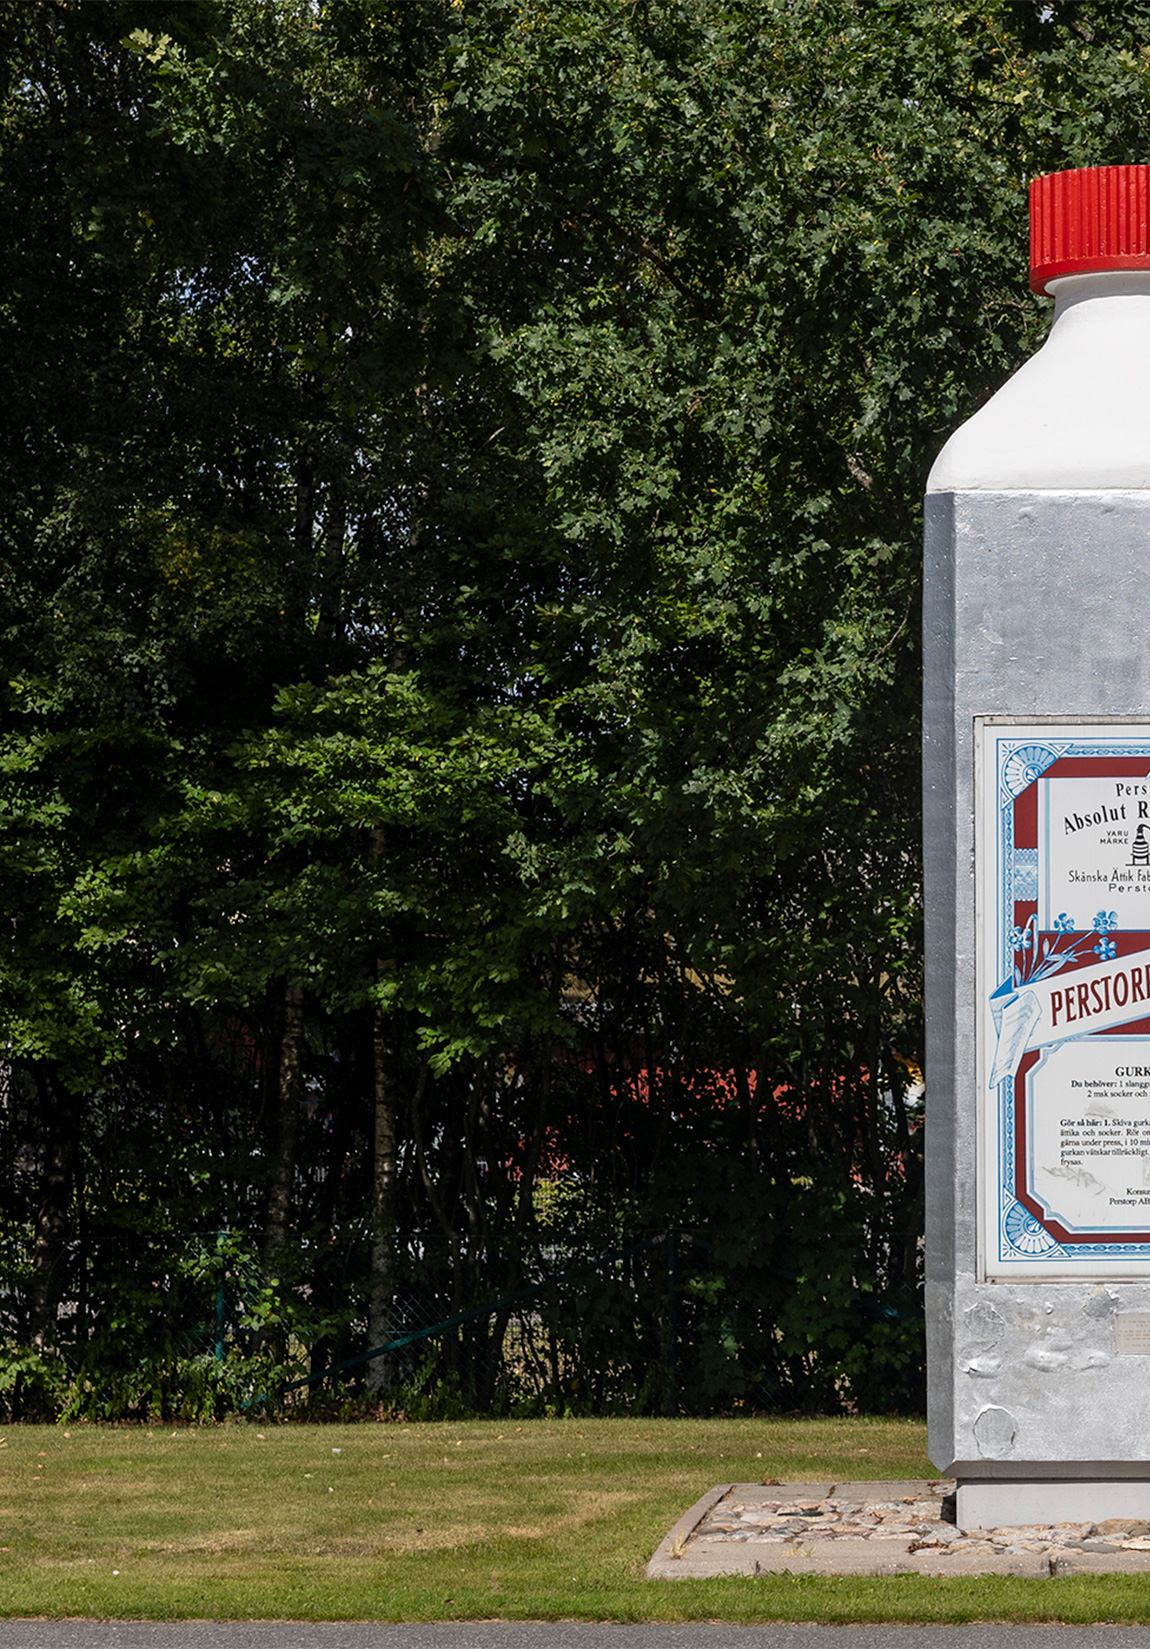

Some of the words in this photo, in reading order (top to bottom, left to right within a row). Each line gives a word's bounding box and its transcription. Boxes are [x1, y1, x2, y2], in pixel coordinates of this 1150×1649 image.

[1065, 804, 1127, 835] Absolut
[1100, 836, 1128, 844] MÄRKE
[1069, 870, 1108, 882] Skånska
[1111, 868, 1133, 881] Ättik
[1061, 1139, 1080, 1148] gärna
[1103, 1140, 1123, 1148] press,
[1130, 1138, 1138, 1146] 10
[1061, 1148, 1085, 1157] gurkan
[1109, 1198, 1137, 1206] Perstorp
